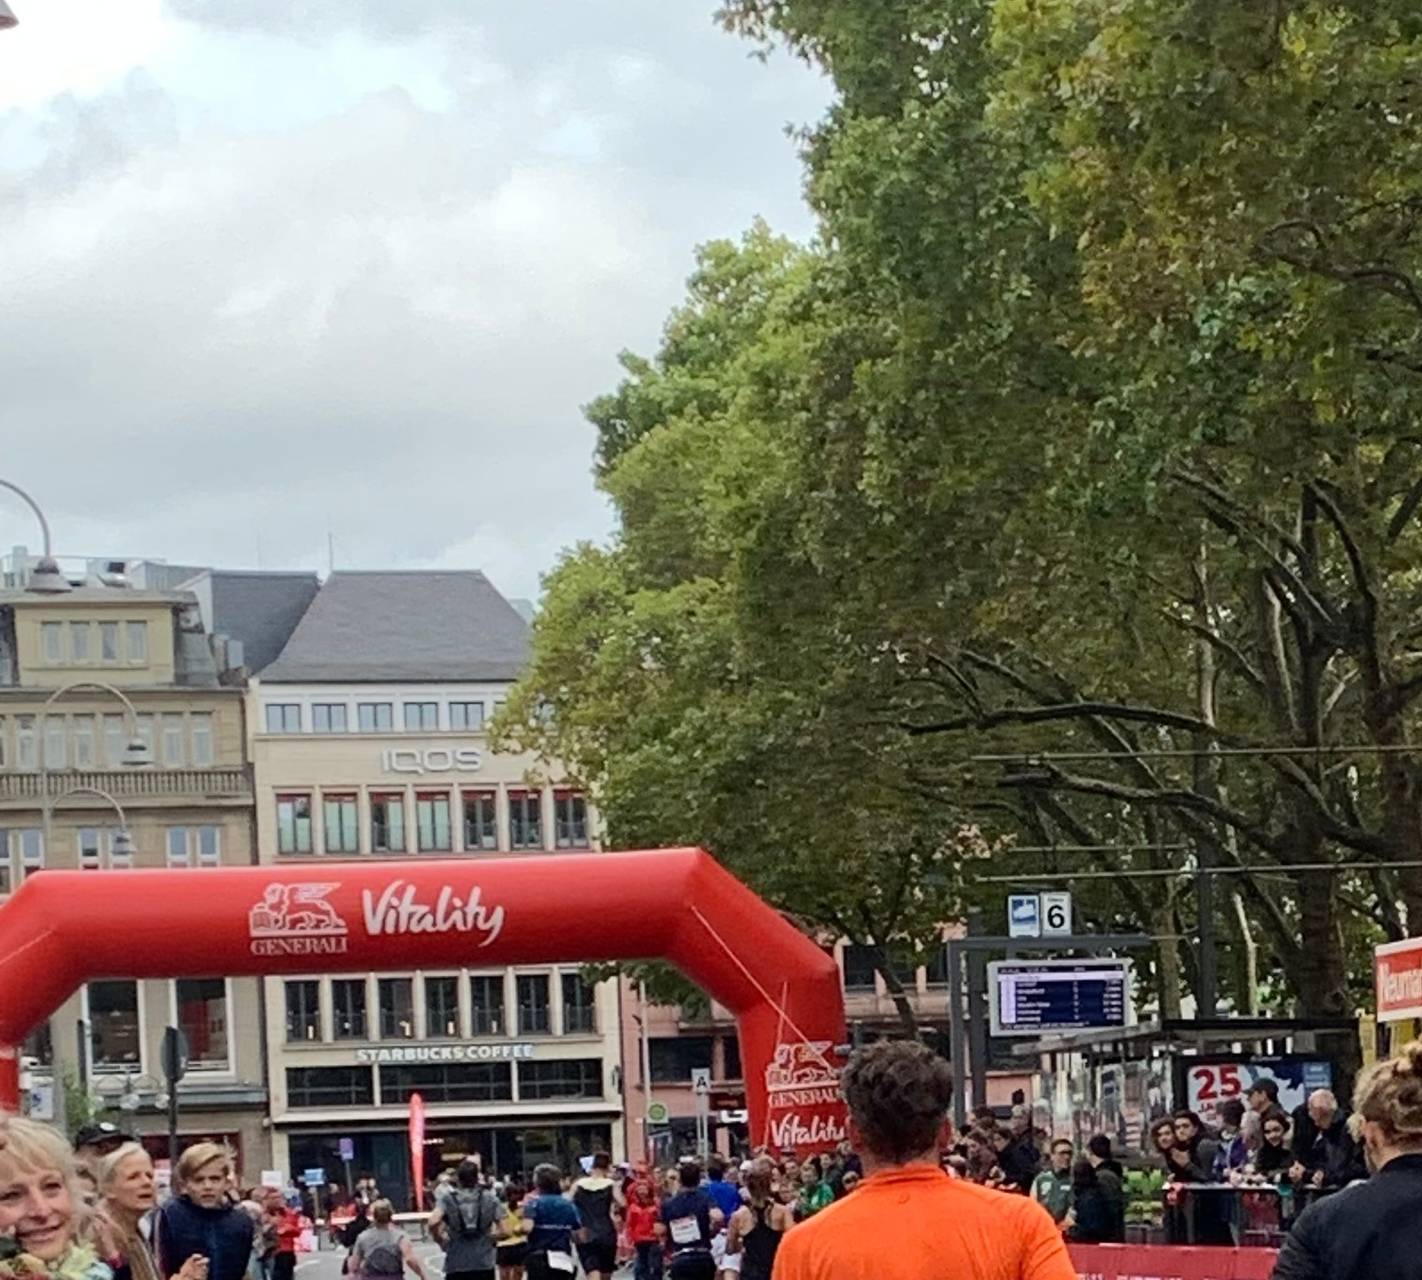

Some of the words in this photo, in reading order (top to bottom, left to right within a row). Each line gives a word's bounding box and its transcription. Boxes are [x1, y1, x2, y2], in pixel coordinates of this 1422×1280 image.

[383, 748, 482, 775] IQOS
[362, 879, 505, 948] Vitality
[1047, 904, 1065, 929] 6
[251, 936, 348, 956] GENERALI
[357, 1047, 465, 1062] STARBUCKS
[466, 1044, 534, 1060] COFFEE
[1193, 1063, 1242, 1101] 25
